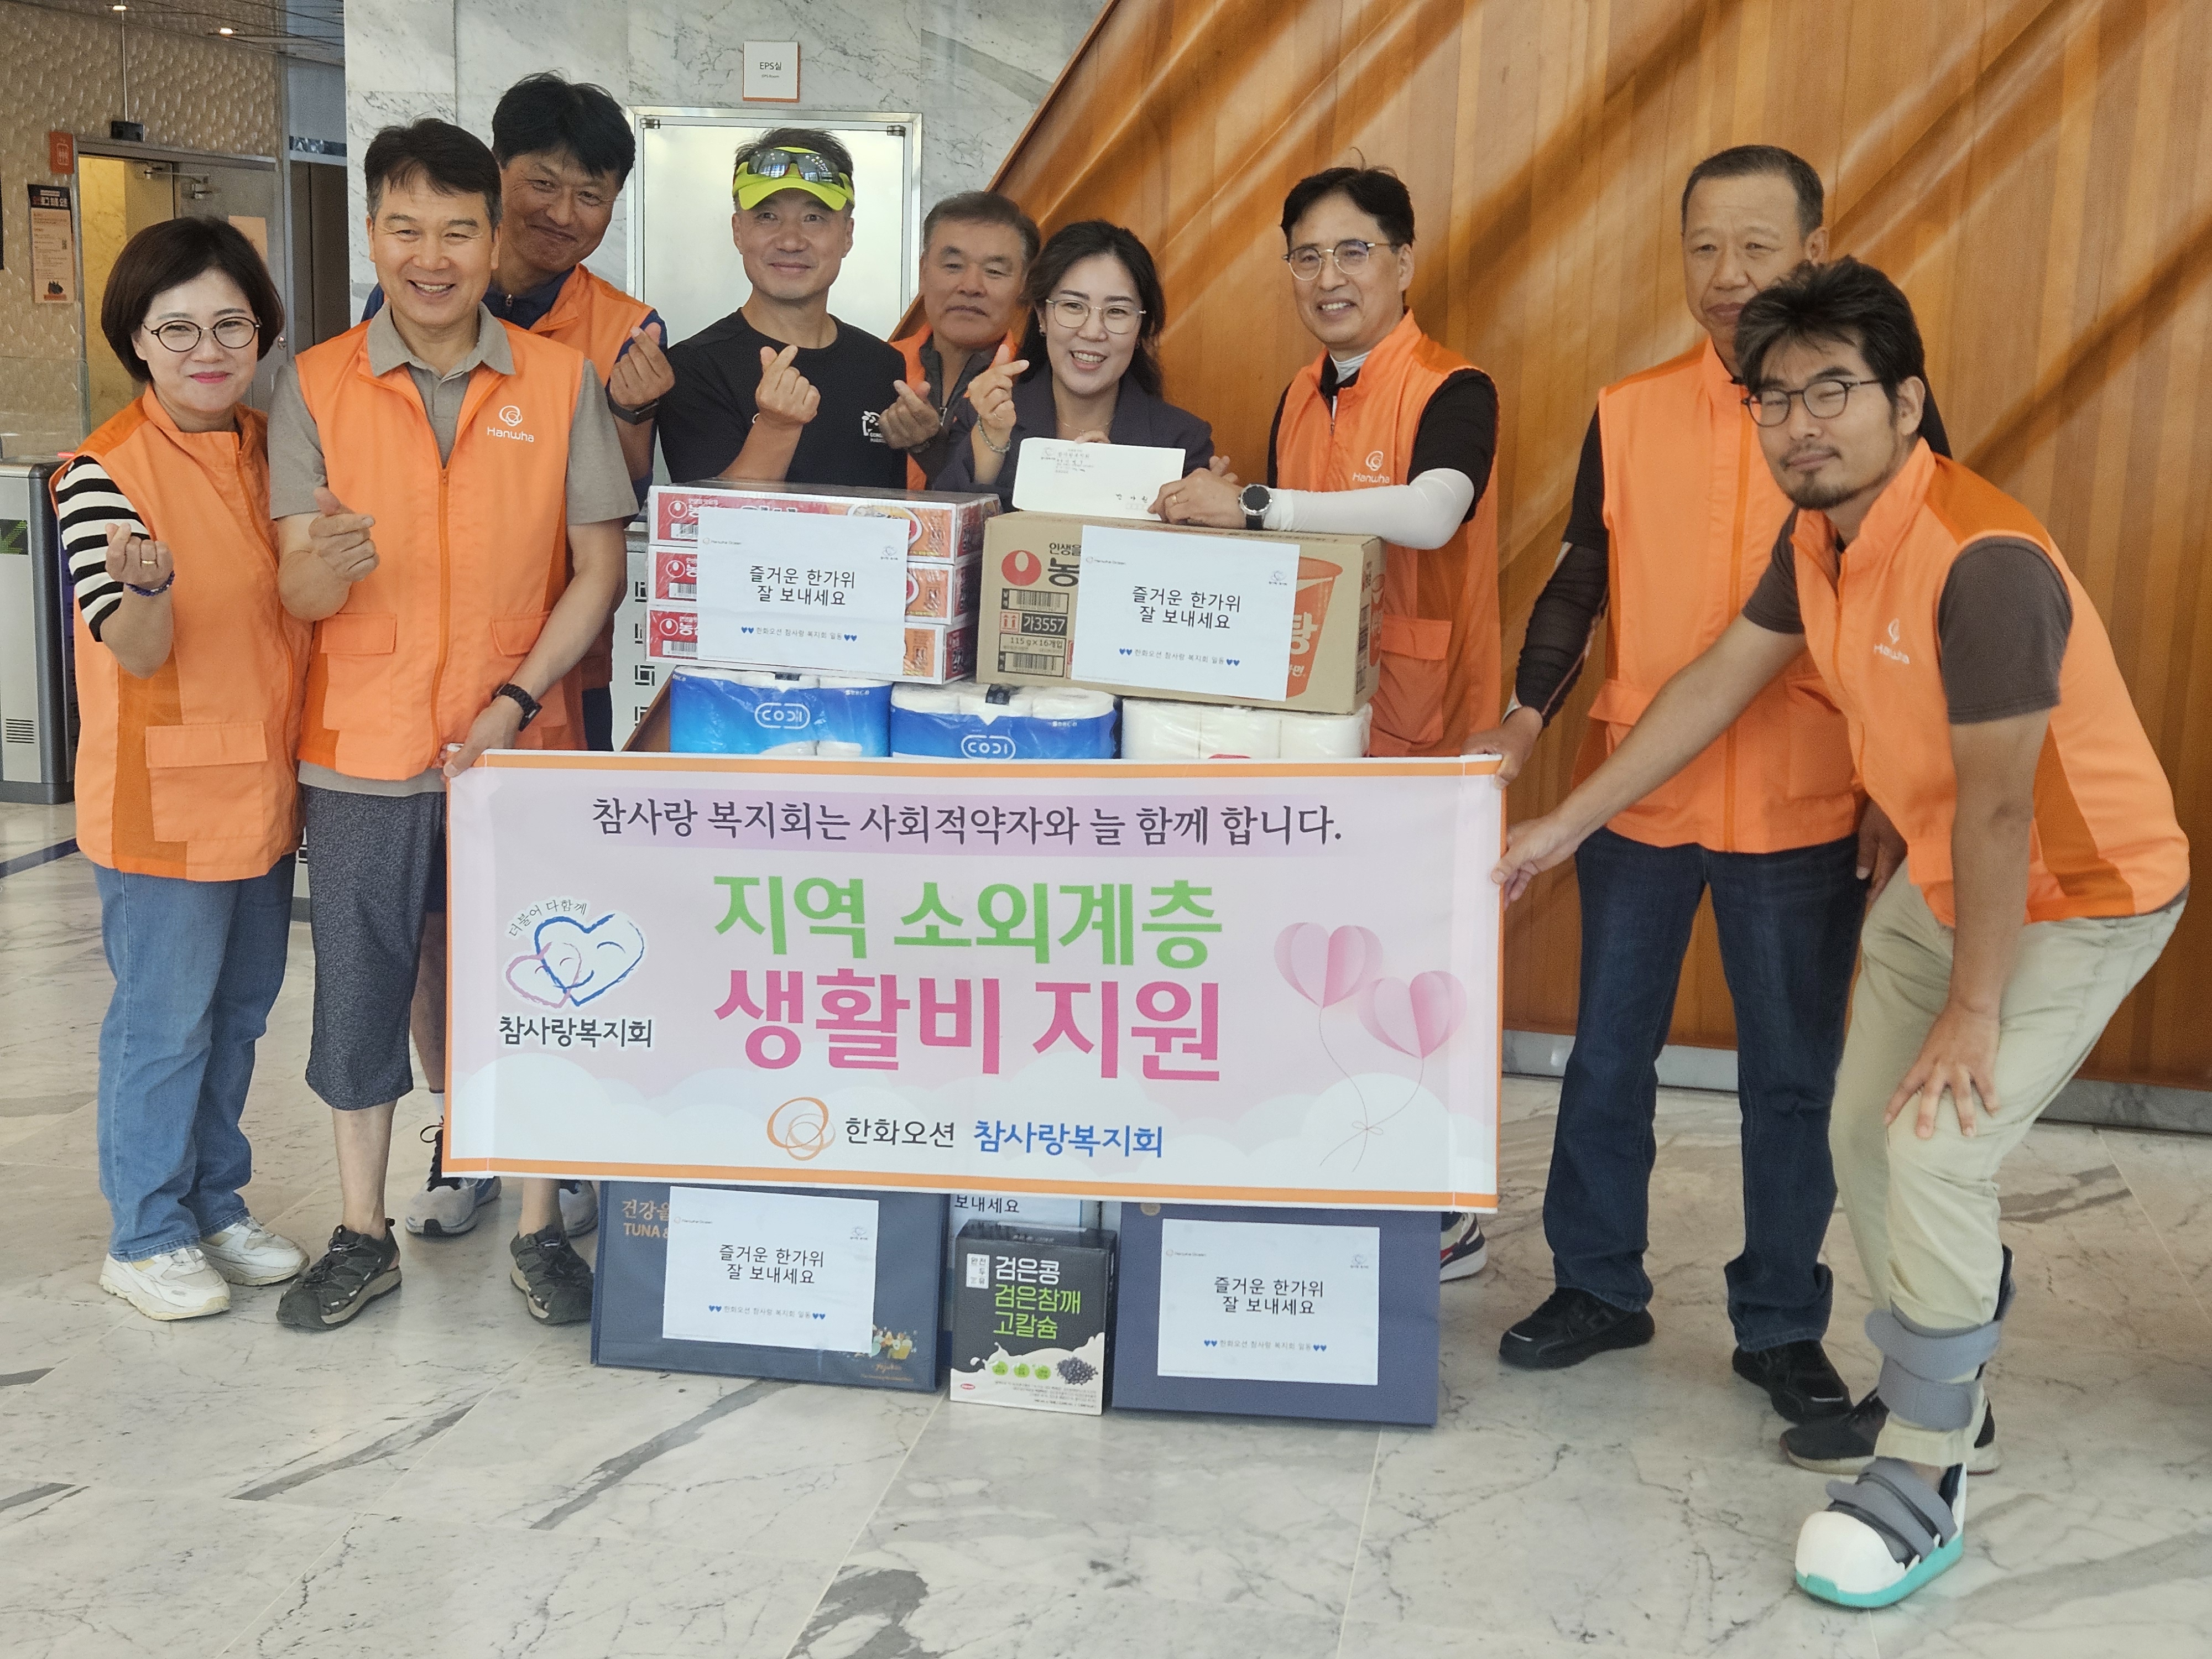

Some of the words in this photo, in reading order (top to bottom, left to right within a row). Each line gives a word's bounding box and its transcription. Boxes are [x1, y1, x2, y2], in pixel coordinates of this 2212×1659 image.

[759, 62, 782, 71] EPS실
[487, 426, 535, 443] Hanwha
[1352, 472, 1390, 484] Hanwha
[1049, 542, 1082, 556] 인생을
[749, 565, 799, 585] 즐거운
[807, 569, 855, 589] 한가위
[757, 585, 773, 602] 잘
[780, 587, 846, 607] 보내세요
[1133, 586, 1182, 606] 즐거운
[1191, 591, 1240, 613] 한가위
[1023, 615, 1066, 633] 가3557
[1140, 606, 1156, 623] 잘
[1162, 609, 1230, 629] 보내세요
[593, 797, 698, 837] 참사랑
[707, 801, 851, 841] 복지회는
[860, 804, 1080, 846] 사회적약자와
[1089, 808, 1126, 846] 늘
[1136, 806, 1208, 846] 함께
[1220, 805, 1342, 846] 합니다.
[508, 905, 542, 937] 더불어
[714, 876, 867, 959] 지역
[894, 880, 1222, 969] 소외계층
[499, 1016, 651, 1048] 참사랑복지회
[714, 968, 1000, 1075] 생활비
[1033, 981, 1219, 1081] 지원
[846, 1118, 956, 1149] 한화오션
[974, 1120, 1163, 1158] 참사랑복지회
[622, 1199, 669, 1221] 건강을
[954, 1194, 1020, 1213] 보내세요
[623, 1222, 661, 1238] TUNA
[719, 1244, 768, 1263] 즐거운
[776, 1248, 824, 1268] 한가위
[727, 1264, 743, 1280] 잘
[749, 1265, 816, 1285] 보내세요
[995, 1256, 1061, 1285] 검은콩
[994, 1283, 1082, 1314] 검은참깨
[1214, 1276, 1265, 1295] 즐거운
[1273, 1279, 1323, 1298] 한가위
[1223, 1296, 1239, 1313] 잘
[1246, 1298, 1315, 1316] 보내세요
[993, 1311, 1058, 1339] 고칼슘
